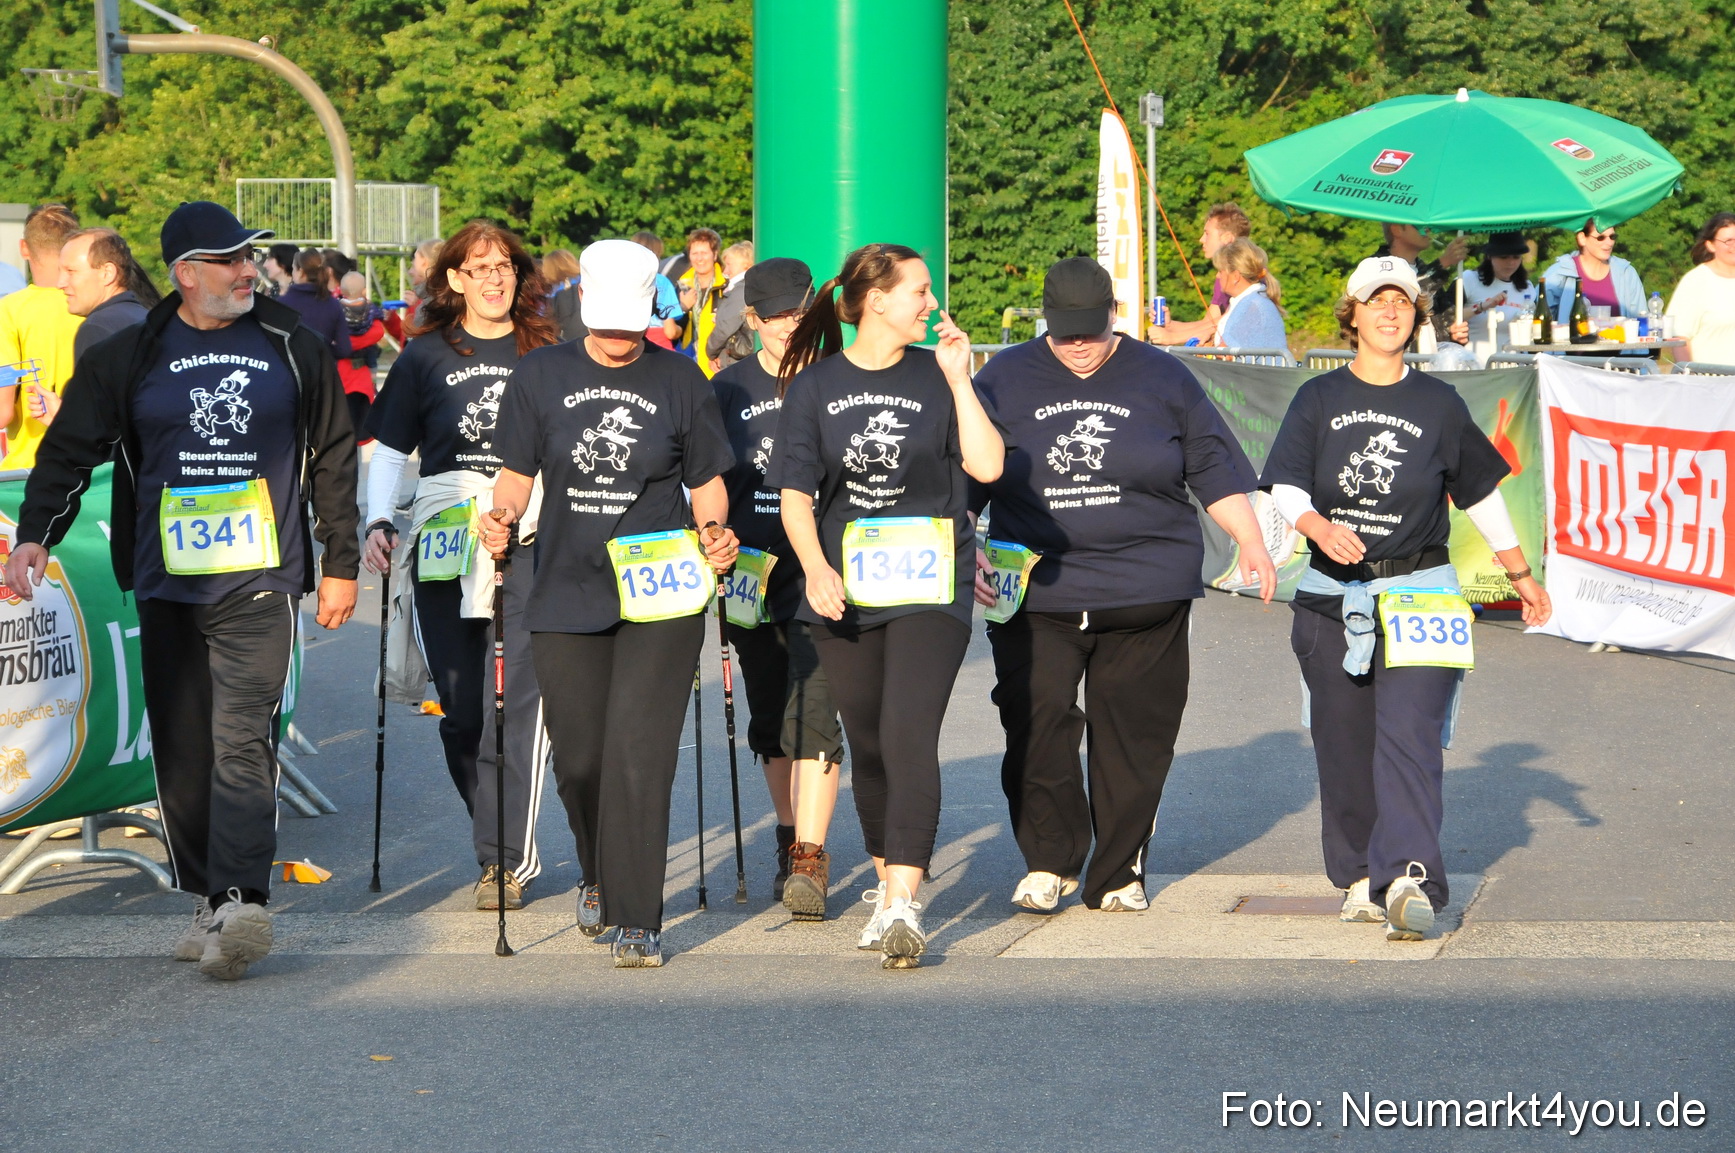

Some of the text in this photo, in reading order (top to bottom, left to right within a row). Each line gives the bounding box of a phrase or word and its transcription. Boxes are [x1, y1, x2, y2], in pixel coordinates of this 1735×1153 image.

[1577, 152, 1627, 179] Neumarkter
[1579, 157, 1653, 193] Lammsbräu
[1312, 179, 1418, 208] Lammsbräu
[1336, 172, 1414, 193] Neumarkter
[169, 352, 270, 373] Chickenrun
[563, 385, 658, 415] Chickenrun
[740, 396, 783, 420] Chick
[827, 391, 923, 416] Chickenrun
[1034, 399, 1132, 421] Chickenrun
[1330, 409, 1424, 438] Chickenrun
[209, 436, 230, 446] der
[178, 451, 258, 462] Steuerkanzlei
[181, 466, 253, 476] Heinz Müller
[595, 474, 615, 485] der
[868, 474, 888, 483] der
[1072, 473, 1092, 483] der
[566, 487, 638, 501] Steuerkanzle
[753, 491, 781, 500] Steue
[1049, 494, 1122, 511] Heinz Müller
[1358, 497, 1379, 507] der
[1566, 430, 1727, 579] MEIER
[570, 501, 600, 514] Heinz
[754, 504, 780, 514] Heinz
[1329, 507, 1403, 524] Steuerkanzlei
[167, 513, 254, 551] 1341
[1360, 523, 1394, 536] Müller
[849, 549, 937, 582] 1342
[621, 560, 702, 599] 1343
[991, 570, 1022, 603] 345
[724, 574, 759, 608] 344
[0, 607, 58, 645] markter
[1387, 614, 1470, 646] 1338
[0, 698, 78, 729] ologische Bier
